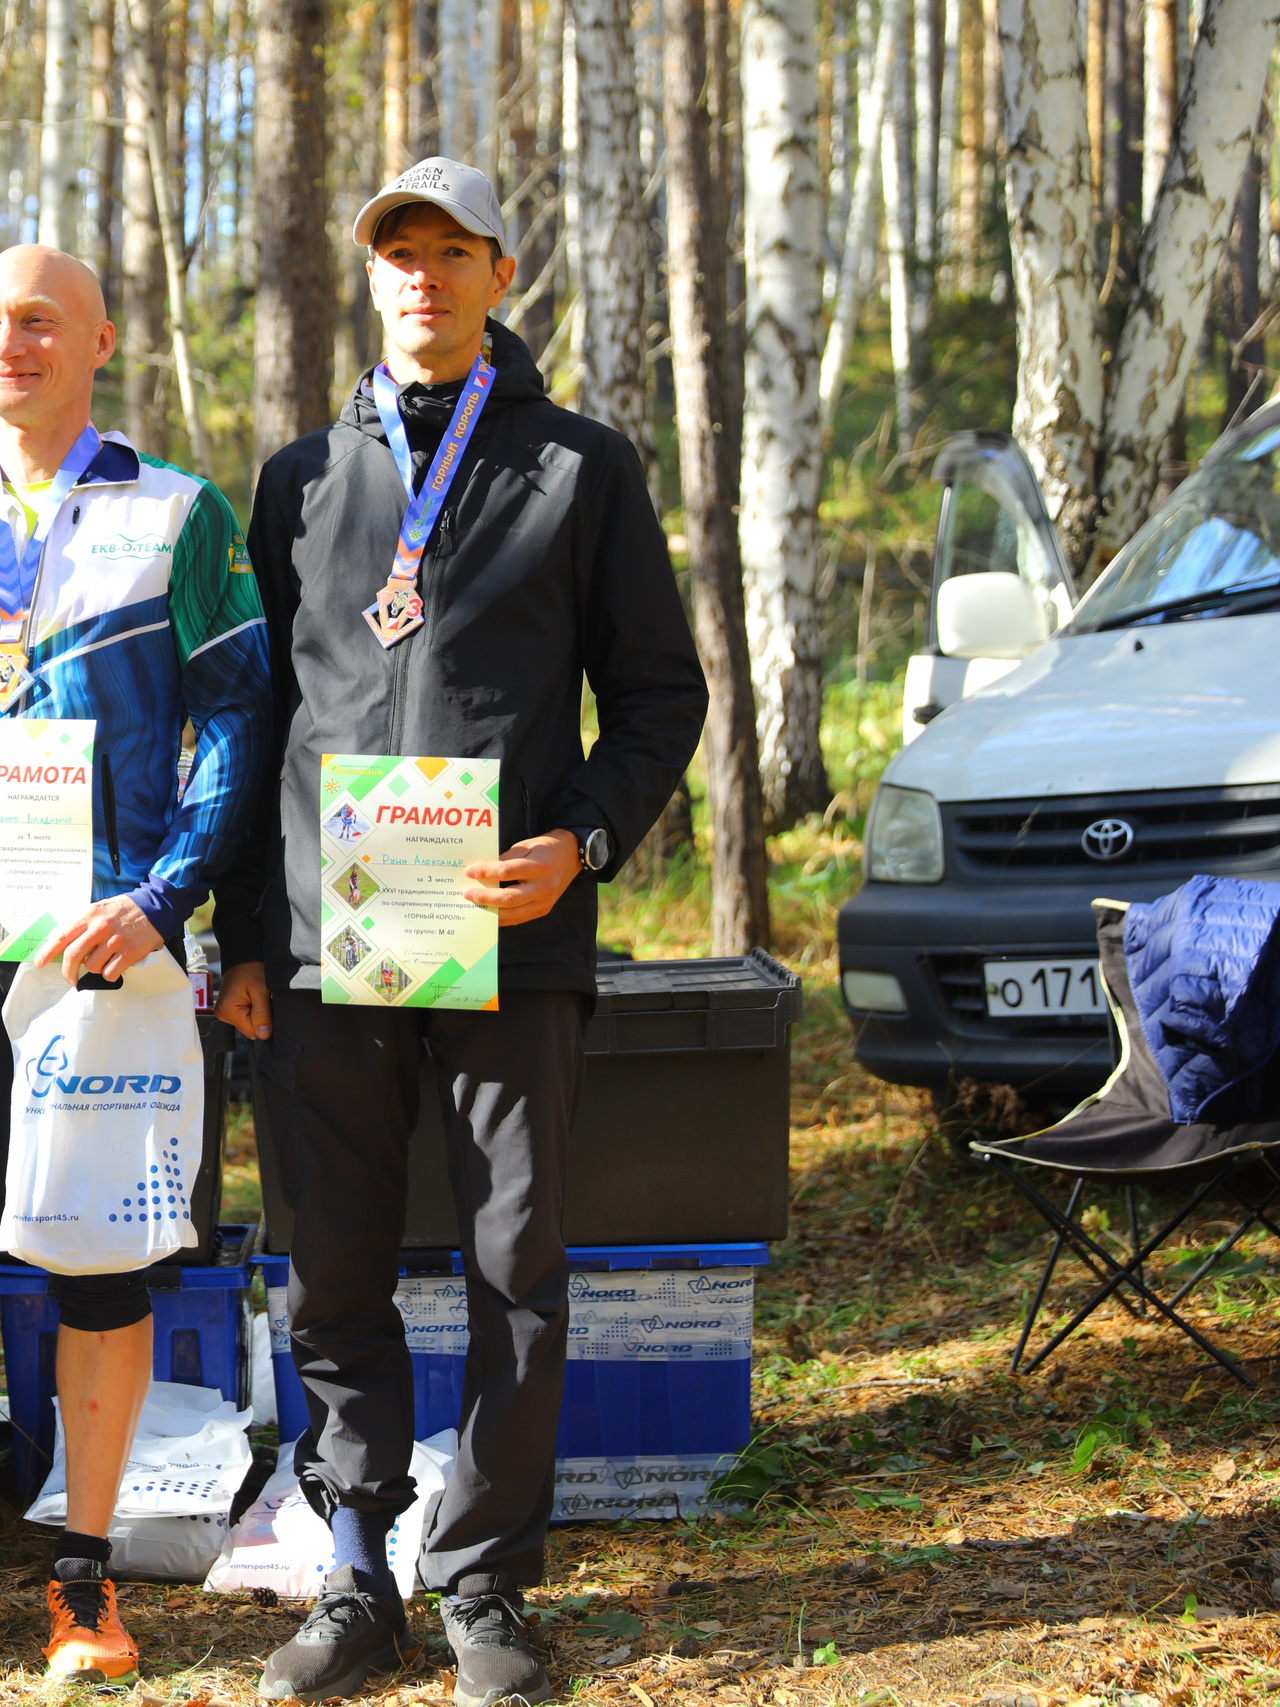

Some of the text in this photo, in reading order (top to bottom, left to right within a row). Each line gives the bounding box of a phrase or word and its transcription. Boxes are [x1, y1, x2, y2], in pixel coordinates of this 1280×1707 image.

[409, 166, 443, 176] OPEN
[405, 181, 450, 191] TRAILS
[431, 391, 480, 491] ГОРНЫЙ КОРОЛЬ
[91, 542, 172, 554] EKB-O-TEAM
[405, 598, 423, 618] 3
[7, 794, 60, 802] НАГРАЖДАЕТСЯ
[375, 805, 493, 827] ГРАМОТА
[405, 836, 463, 844] НАГРАЖДАЕТСЯ
[427, 875, 432, 883] 3
[397, 888, 445, 896] традиционных
[195, 988, 204, 1008] 1
[55, 1074, 182, 1095] NORD
[92, 1101, 147, 1111] СПОРТИВНАЯ
[150, 1101, 181, 1112] ОДЕЖДА
[12, 1213, 79, 1224] wntersport45.ru
[581, 1289, 637, 1298] NORD
[410, 1324, 467, 1333] NORD
[664, 1320, 721, 1329] NORD
[636, 1343, 692, 1353] NORD
